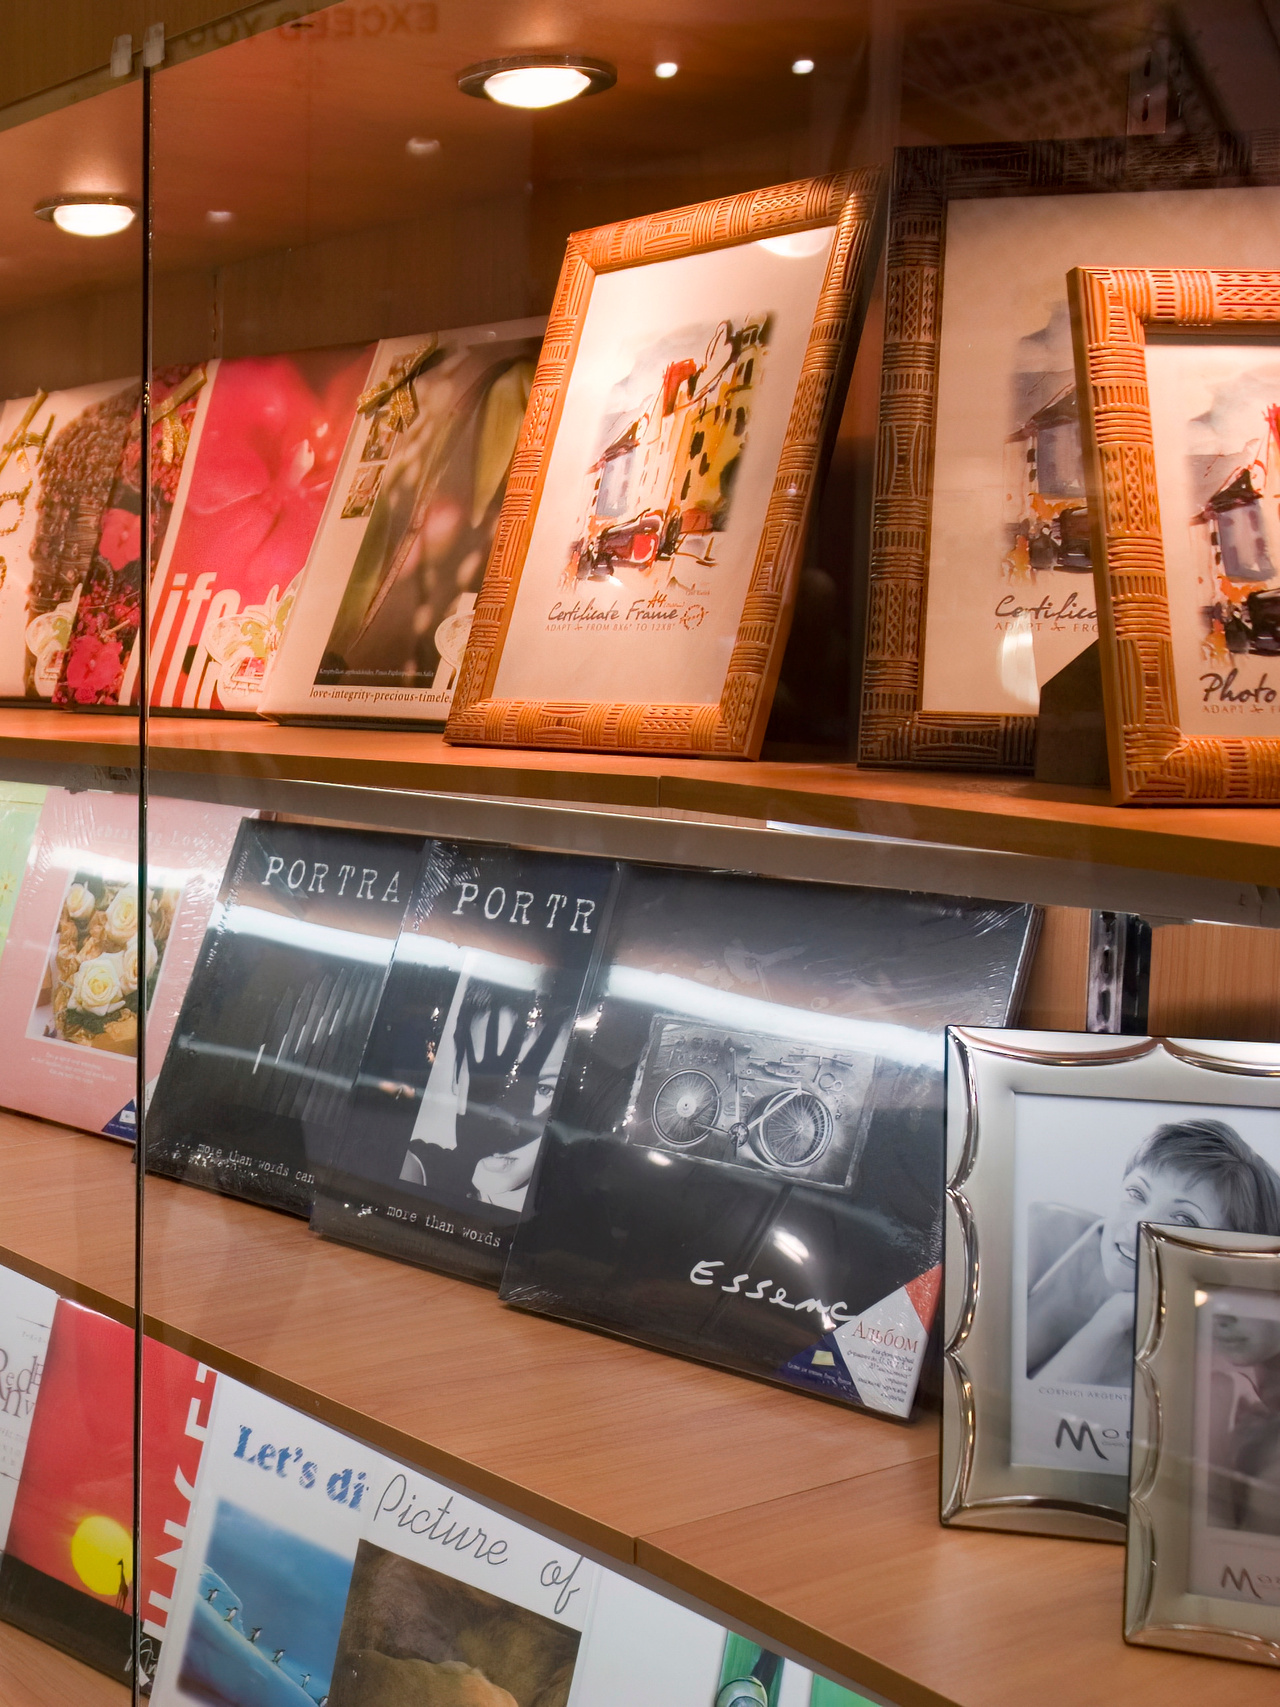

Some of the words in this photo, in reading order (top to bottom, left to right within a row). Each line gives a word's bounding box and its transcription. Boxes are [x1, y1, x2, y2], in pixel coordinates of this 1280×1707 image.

[547, 597, 620, 625] Certificate
[625, 598, 678, 621] Frame
[647, 590, 667, 608] A4
[544, 623, 571, 632] ADAPT
[586, 623, 610, 632] FROM
[636, 623, 647, 632] TO
[1199, 668, 1277, 703] Photo
[1202, 705, 1244, 715] ADAPT
[261, 855, 401, 903] PORTRA
[451, 882, 596, 935] PORTR
[196, 1143, 223, 1158] more
[229, 1150, 252, 1167] than
[258, 1159, 290, 1177] words
[295, 1169, 316, 1184] can
[386, 1206, 417, 1223] more
[425, 1214, 454, 1234] than
[462, 1226, 501, 1248] words
[851, 1321, 919, 1354] Альбом
[233, 1423, 320, 1490] Let's
[372, 1472, 509, 1567] Picture
[539, 1553, 584, 1617] of
